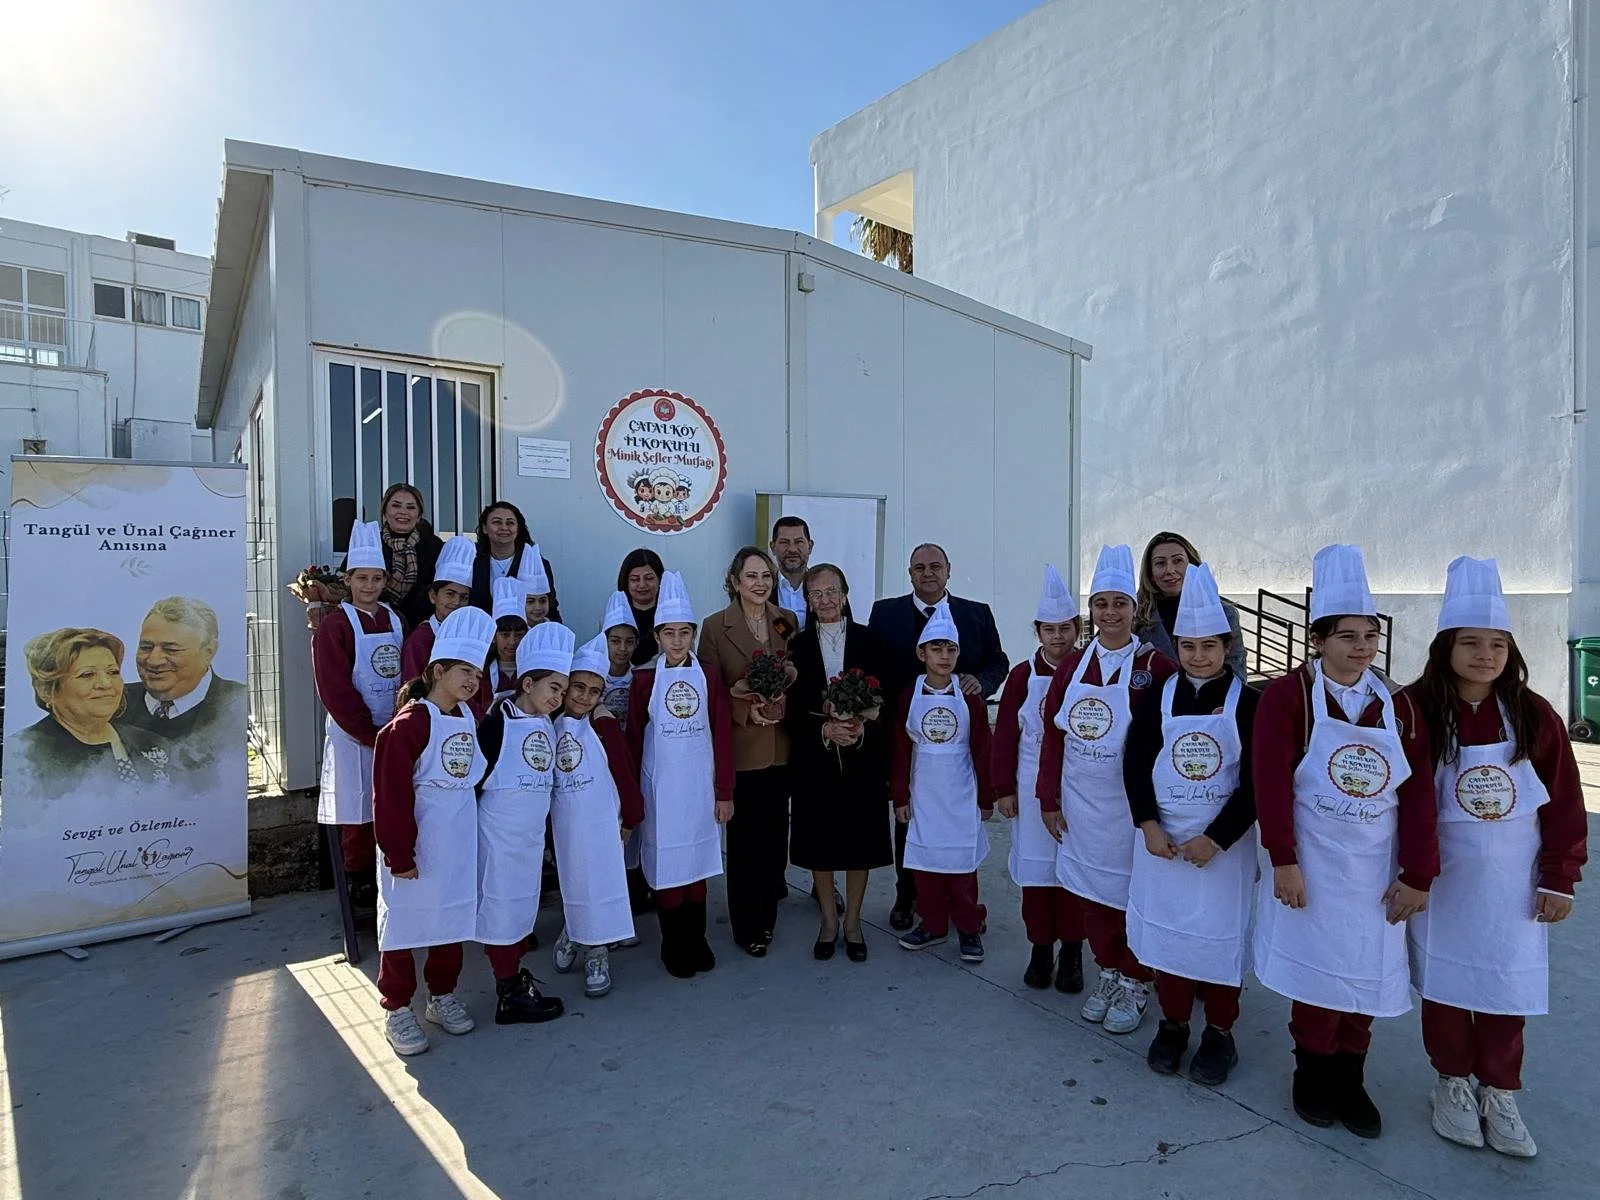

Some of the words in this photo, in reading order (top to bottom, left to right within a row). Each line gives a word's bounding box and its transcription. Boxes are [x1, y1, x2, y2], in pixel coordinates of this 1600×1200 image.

[628, 419, 699, 440] ÇATALKÖY
[623, 433, 700, 454] İLKOKULU
[607, 448, 641, 464] Minik
[642, 451, 672, 466] Şefler
[674, 453, 715, 470] Mutfağı
[23, 523, 91, 539] Tangül
[96, 527, 117, 536] ve
[123, 522, 163, 537] Ünal
[169, 525, 236, 540] Çağıner
[98, 539, 167, 551] Anısına
[62, 825, 103, 841] Sevgi
[108, 826, 124, 836] ve
[129, 817, 197, 833] Özlemle...
